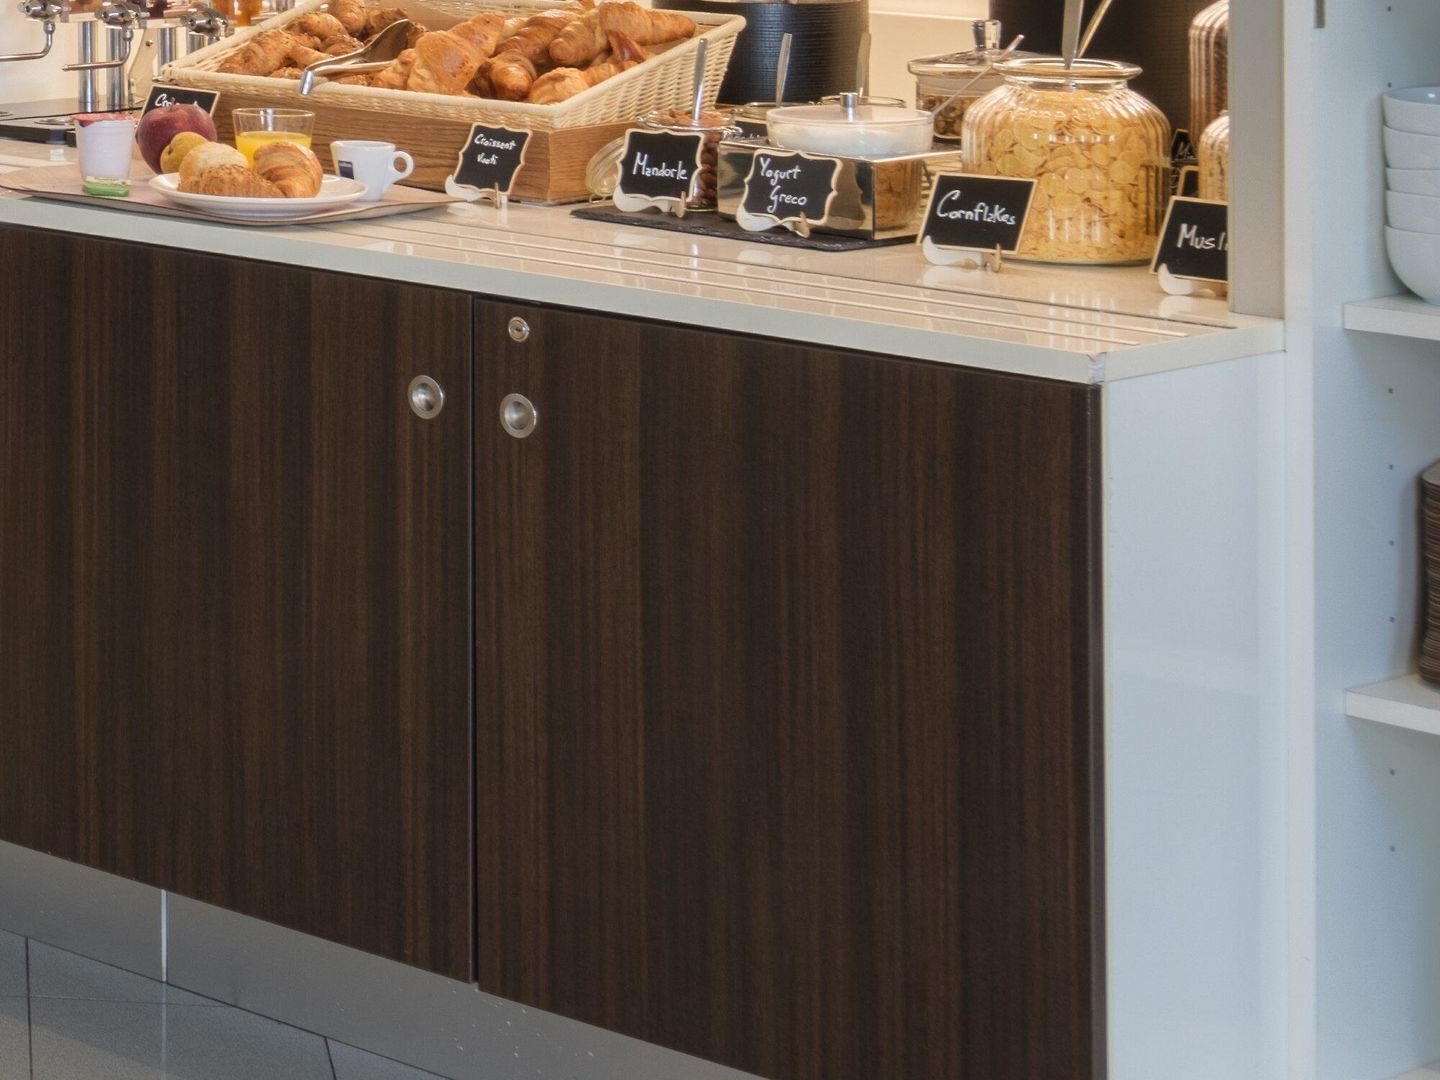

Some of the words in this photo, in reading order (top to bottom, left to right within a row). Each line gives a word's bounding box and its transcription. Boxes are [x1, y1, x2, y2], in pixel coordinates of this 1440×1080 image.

[632, 151, 688, 180] Mandorle
[759, 156, 801, 186] Yogurt
[767, 185, 807, 214] Greco
[936, 189, 1017, 226] Cornflakes
[1176, 223, 1228, 251] Musl
